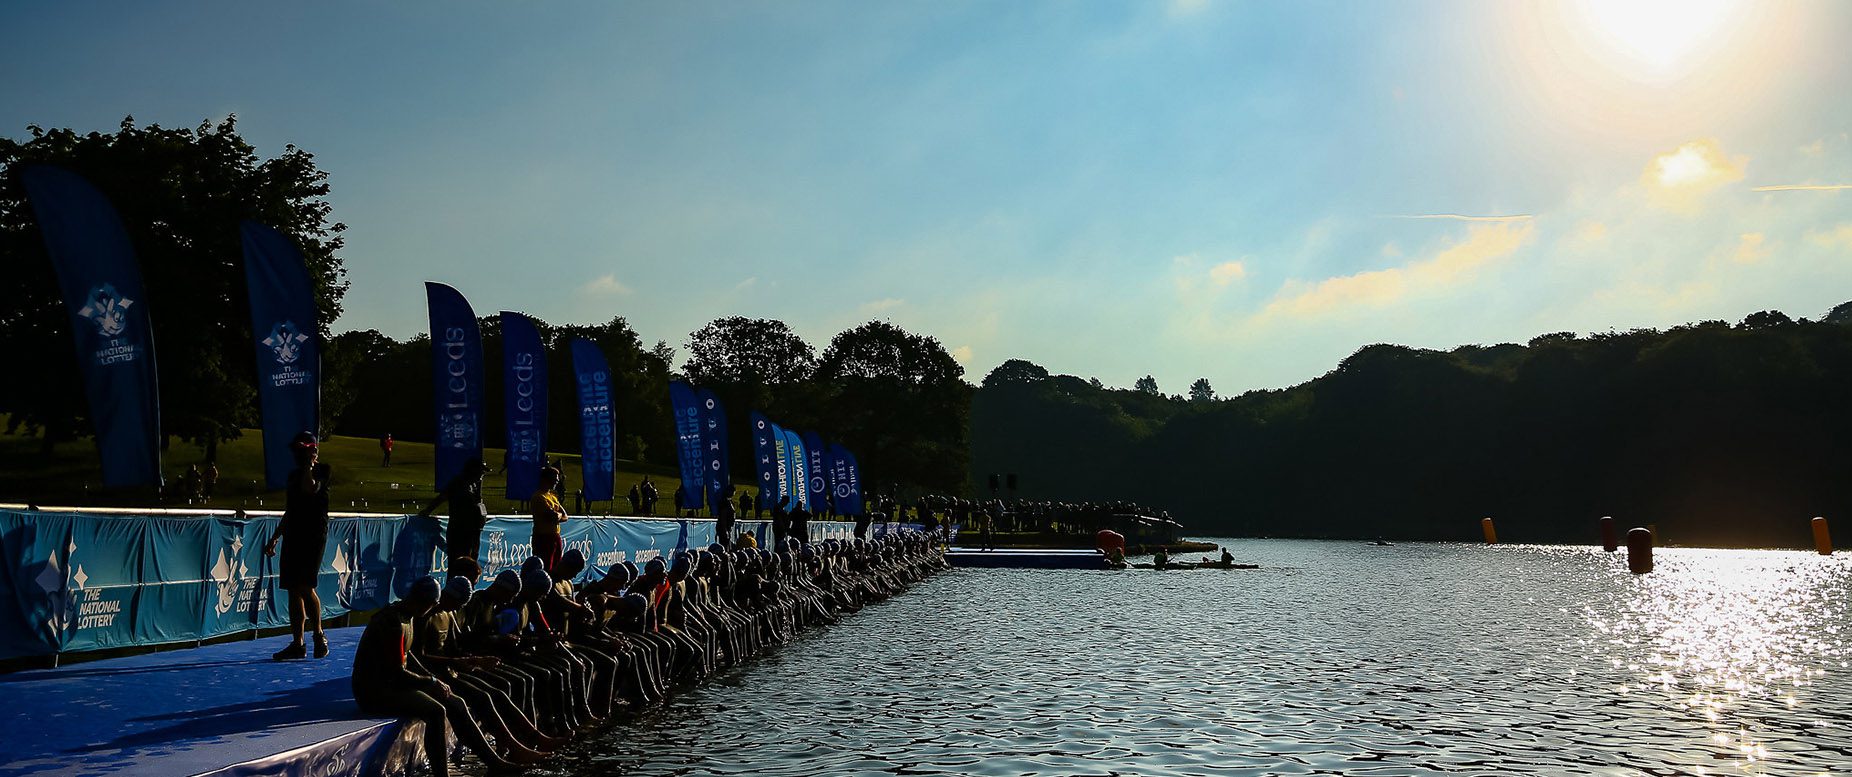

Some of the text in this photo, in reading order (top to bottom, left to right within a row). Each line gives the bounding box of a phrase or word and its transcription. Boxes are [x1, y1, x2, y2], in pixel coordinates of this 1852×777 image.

[96, 345, 136, 358] NATIONA
[100, 352, 134, 366] LOTTE
[441, 327, 468, 408] Leeds
[272, 371, 307, 380] NATIONA
[275, 378, 304, 387] LOTTE
[513, 352, 534, 425] Leeds
[503, 536, 535, 567] Leed
[597, 549, 626, 566] accenture
[243, 579, 257, 589] THE
[83, 589, 102, 602] THE
[238, 588, 268, 601] NATNA
[79, 600, 121, 616] NATIONAL
[236, 600, 268, 613] LOTRY
[77, 613, 115, 630] LOTTERY
